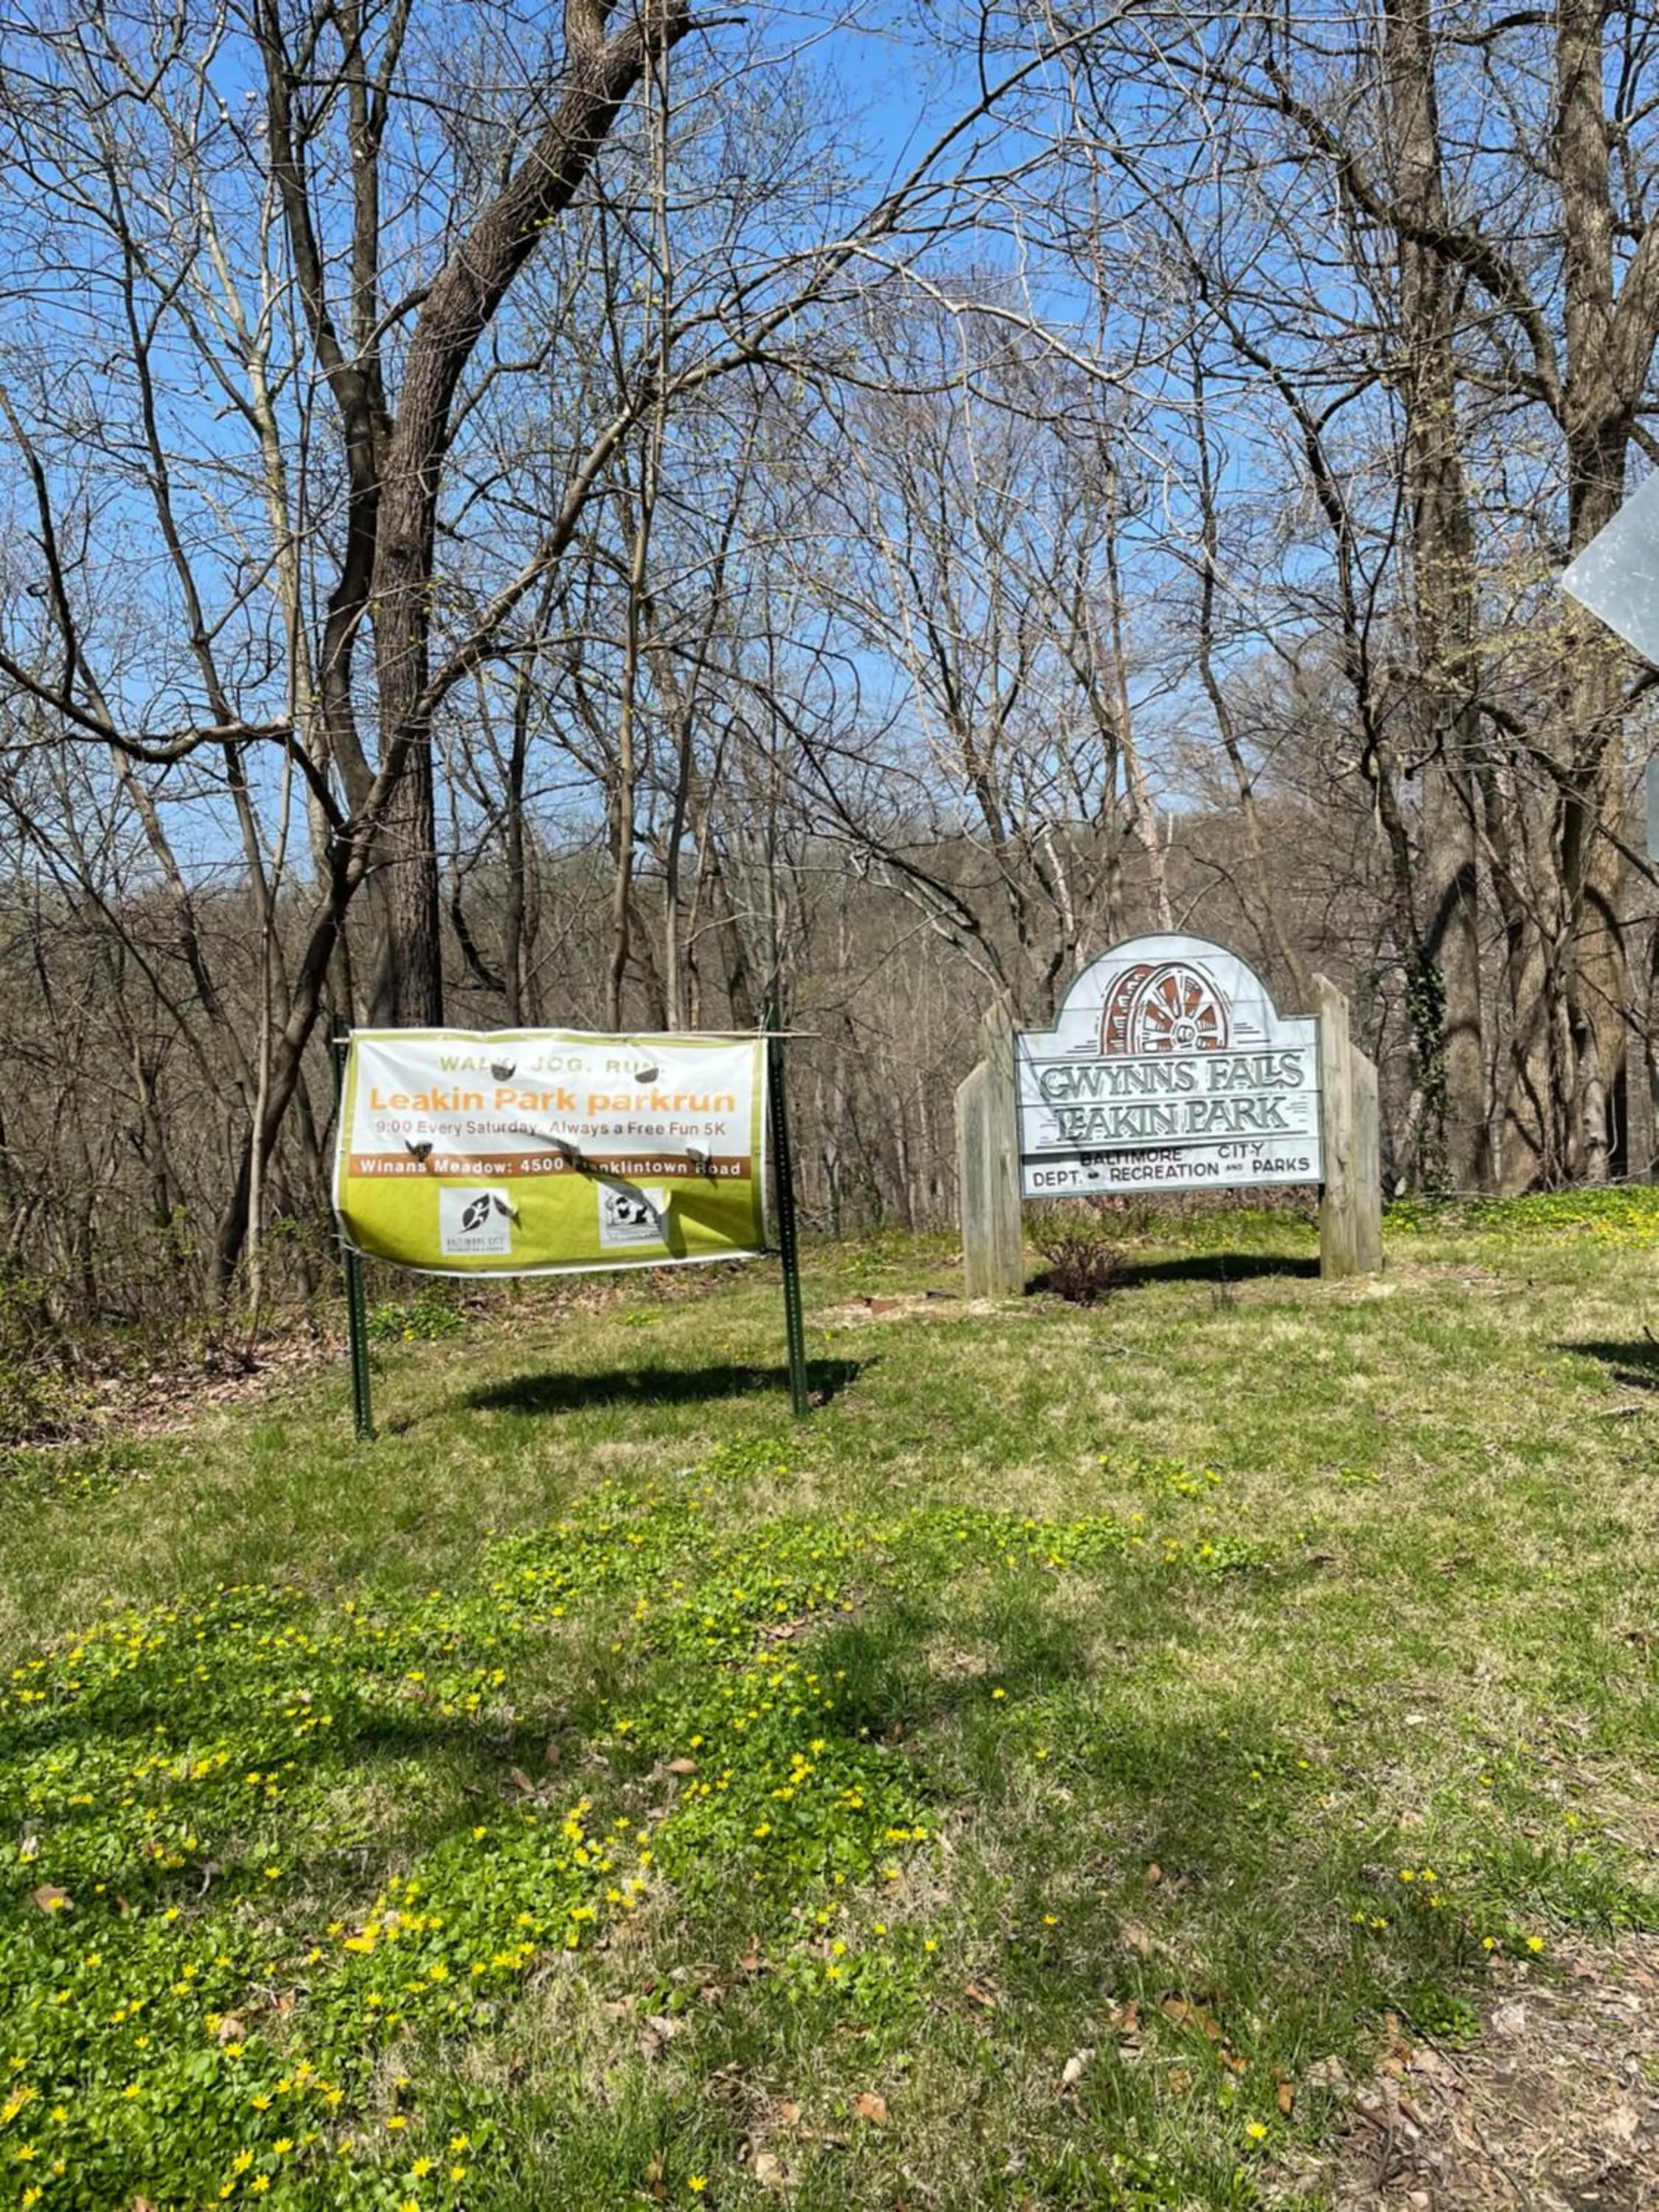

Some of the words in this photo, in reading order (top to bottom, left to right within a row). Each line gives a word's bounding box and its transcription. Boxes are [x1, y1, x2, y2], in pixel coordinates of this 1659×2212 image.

[1040, 1061, 1196, 1099] GWYNNS
[1206, 1053, 1305, 1091] FALLS
[369, 1086, 484, 1110] Leakin
[495, 1087, 577, 1110] Park
[588, 1088, 735, 1116] parkrun
[376, 1121, 412, 1133] 9:00
[417, 1121, 462, 1136] Every
[549, 1121, 609, 1137] Always
[613, 1124, 622, 1135] a
[628, 1122, 664, 1135] Free
[669, 1122, 699, 1135] Fun
[704, 1122, 726, 1135] 5K
[1054, 1103, 1178, 1142] LEAKIN
[1184, 1096, 1289, 1134] PARK
[360, 1158, 426, 1174] Winans
[434, 1159, 512, 1174] Meadow:
[521, 1158, 564, 1172] 4500
[696, 1161, 741, 1175] Road
[1080, 1147, 1183, 1166] BALTIMORE
[1217, 1142, 1265, 1158] CITY
[1033, 1169, 1083, 1187] DEPT.
[1110, 1162, 1219, 1182] RECREATION
[1253, 1157, 1310, 1174] PARKS
